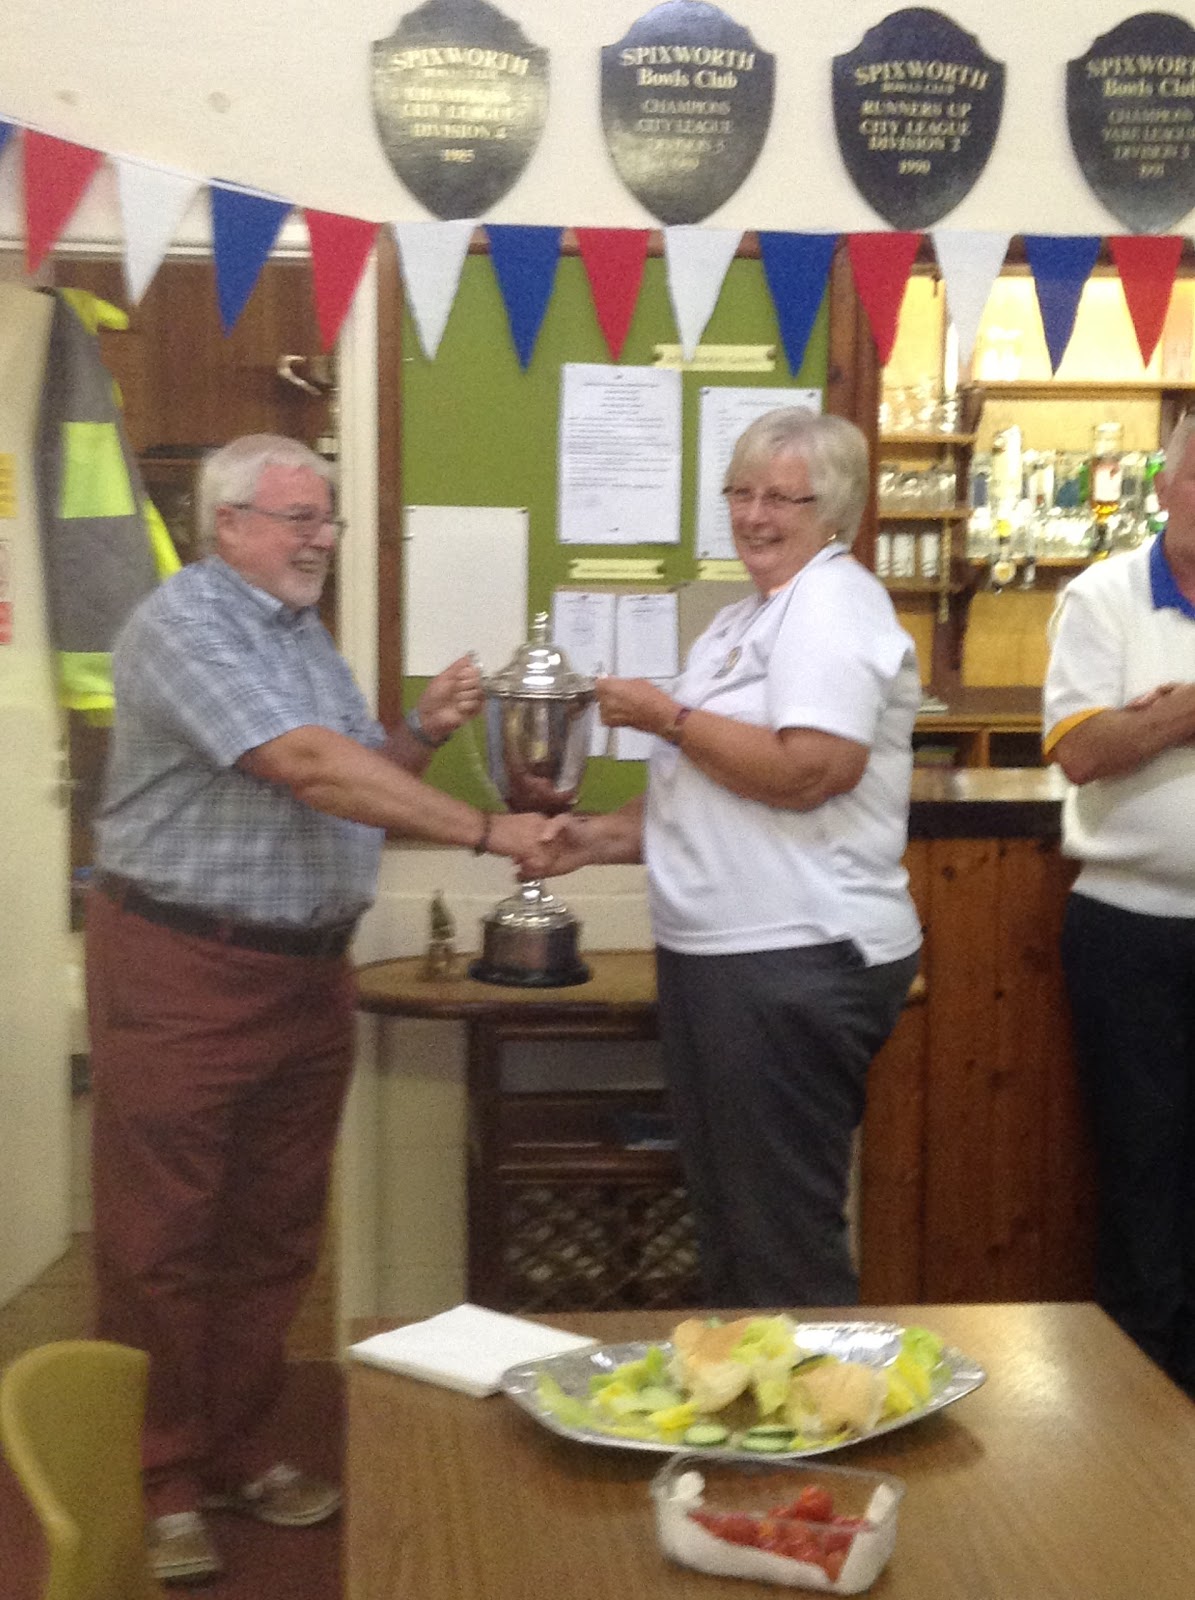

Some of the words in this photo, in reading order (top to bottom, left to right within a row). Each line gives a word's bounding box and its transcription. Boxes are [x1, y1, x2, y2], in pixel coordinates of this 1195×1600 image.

[390, 47, 530, 75] SPIXWORTH
[619, 45, 756, 71] SPIXWORTH
[1085, 55, 1195, 79] SPIXWORT
[636, 68, 690, 87] Bowls
[693, 69, 738, 89] Club
[854, 60, 989, 91] SPIXWORTH
[640, 99, 731, 115] CHAMPIONS
[860, 100, 943, 117] RUNNERS
[946, 102, 972, 118] UP
[858, 120, 899, 135] CITY
[904, 120, 971, 137] LEAGUE
[868, 136, 945, 151] DIVISION
